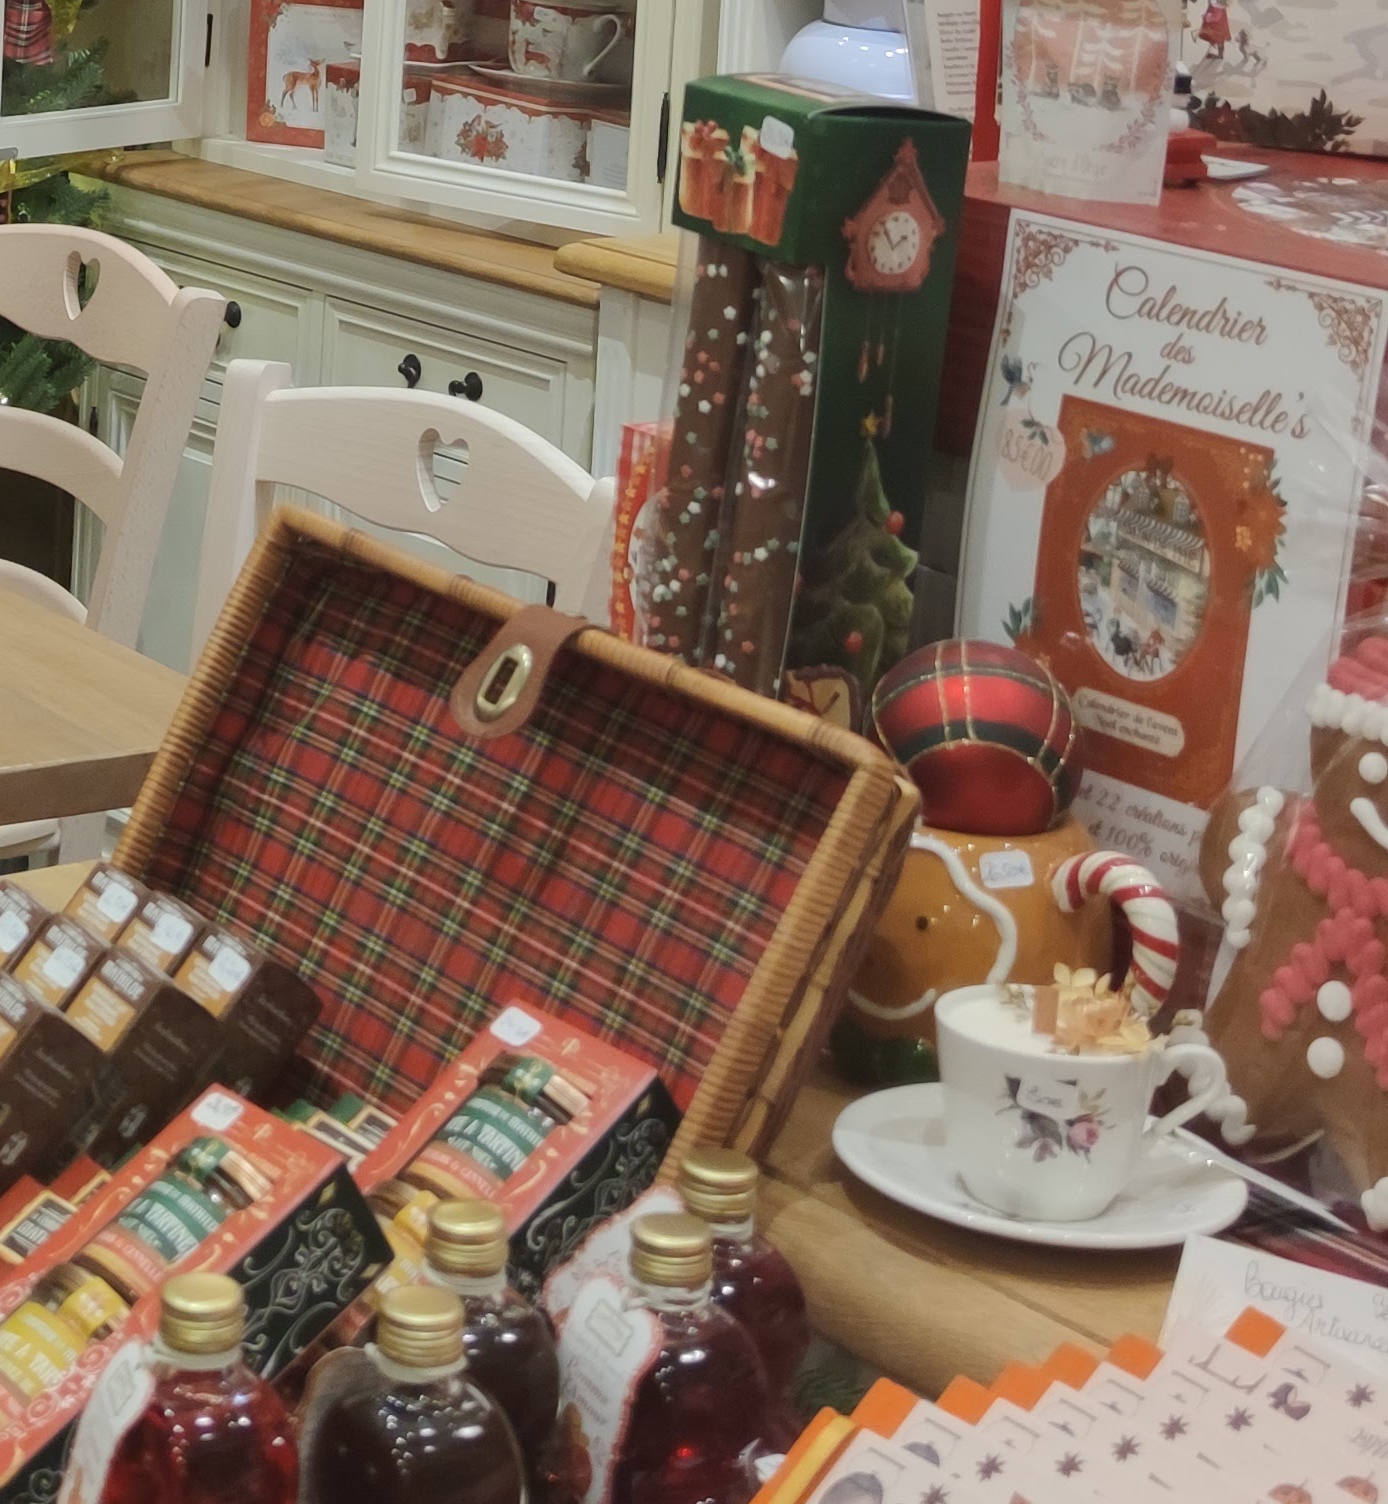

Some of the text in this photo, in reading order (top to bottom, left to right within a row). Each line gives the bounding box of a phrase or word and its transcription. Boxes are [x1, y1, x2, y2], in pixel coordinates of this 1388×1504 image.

[1106, 261, 1268, 346] Calendrier
[1159, 333, 1196, 365] des
[1058, 332, 1310, 440] Mademoiselle's
[1096, 789, 1121, 811] 22
[1106, 824, 1153, 858] 100%
